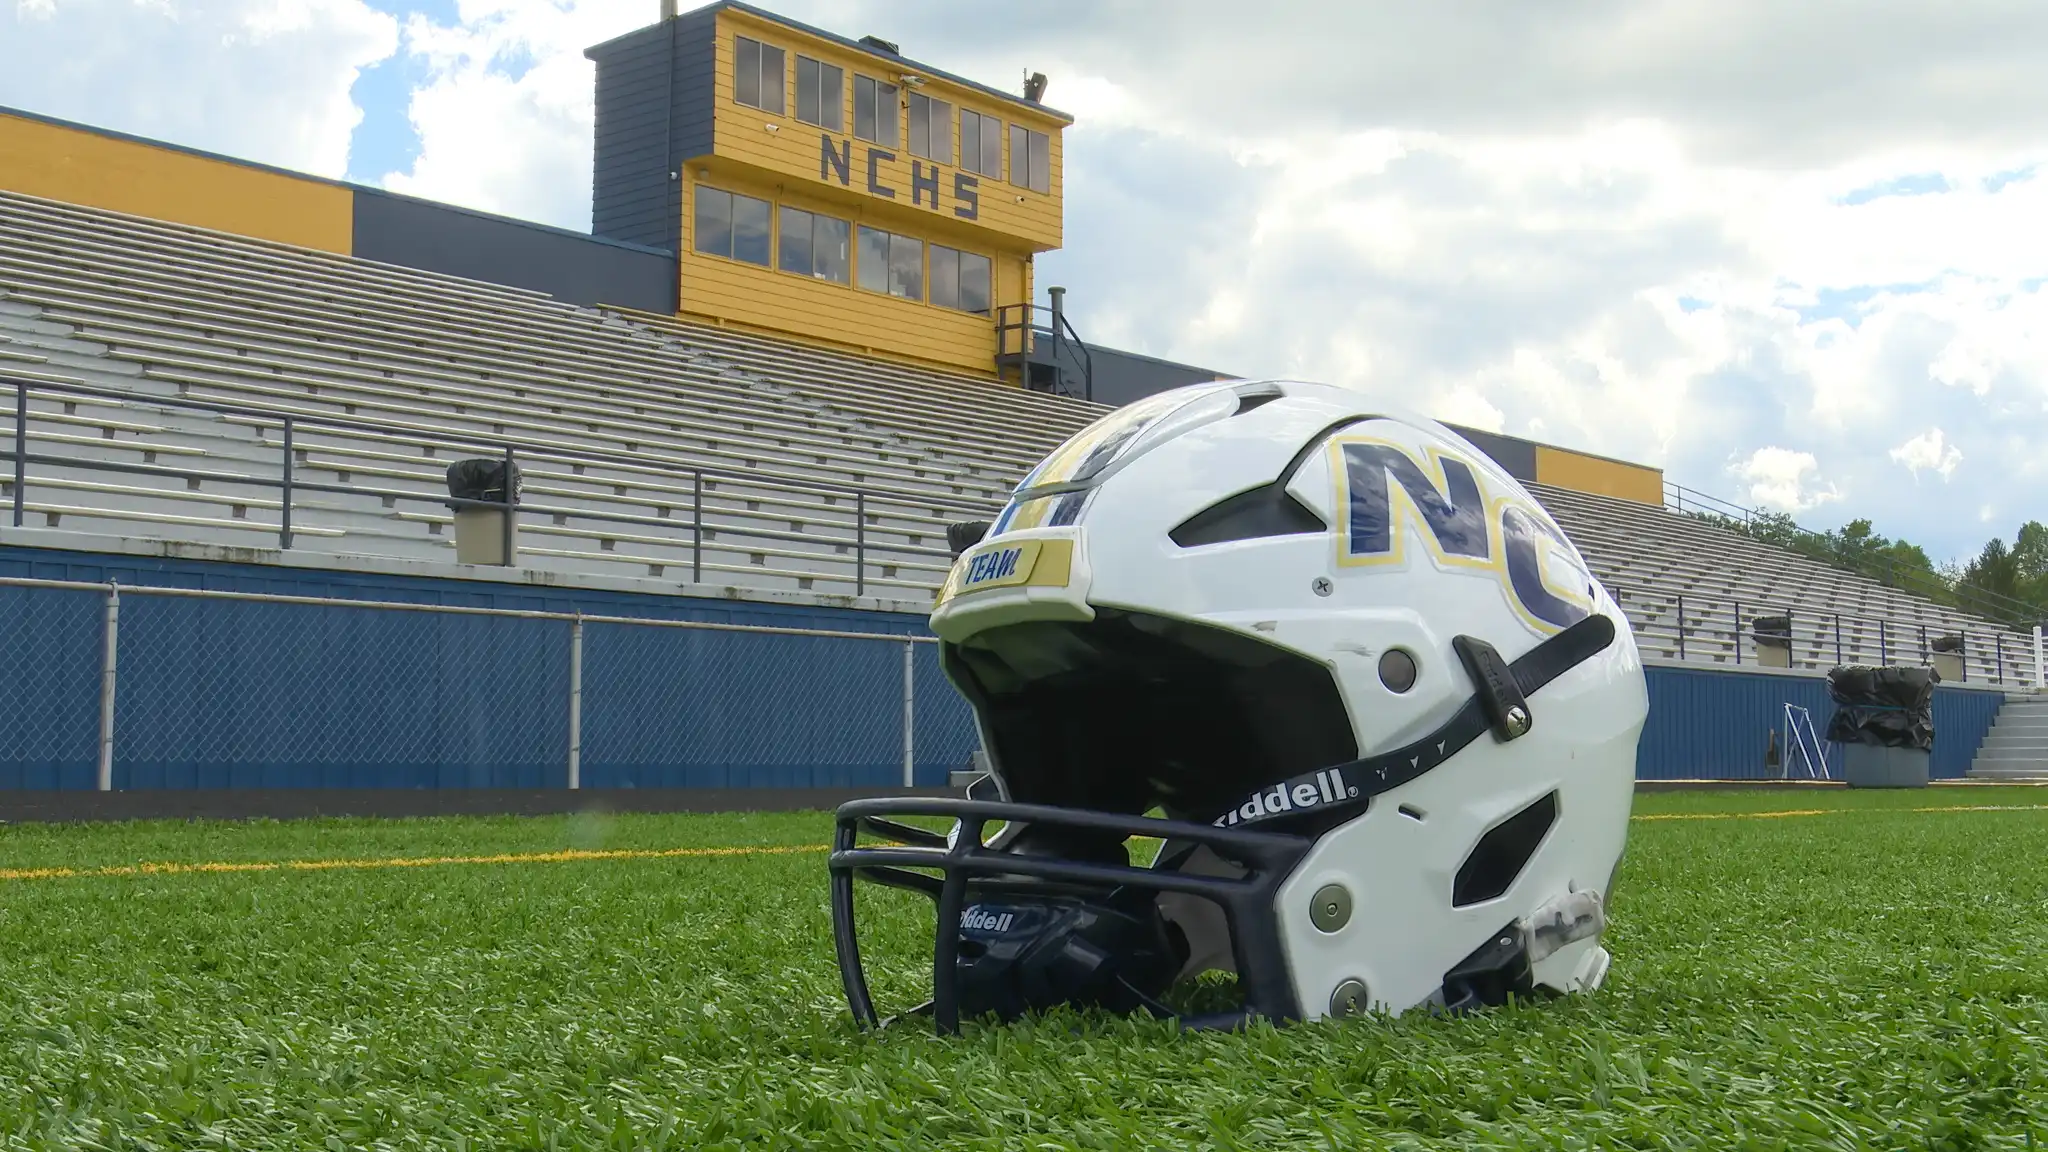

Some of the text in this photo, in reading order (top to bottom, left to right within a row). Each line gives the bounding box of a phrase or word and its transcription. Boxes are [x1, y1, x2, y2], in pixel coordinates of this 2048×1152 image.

[821, 133, 978, 220] NCHS
[965, 547, 1022, 585] TEAM
[1334, 435, 1597, 635] NC
